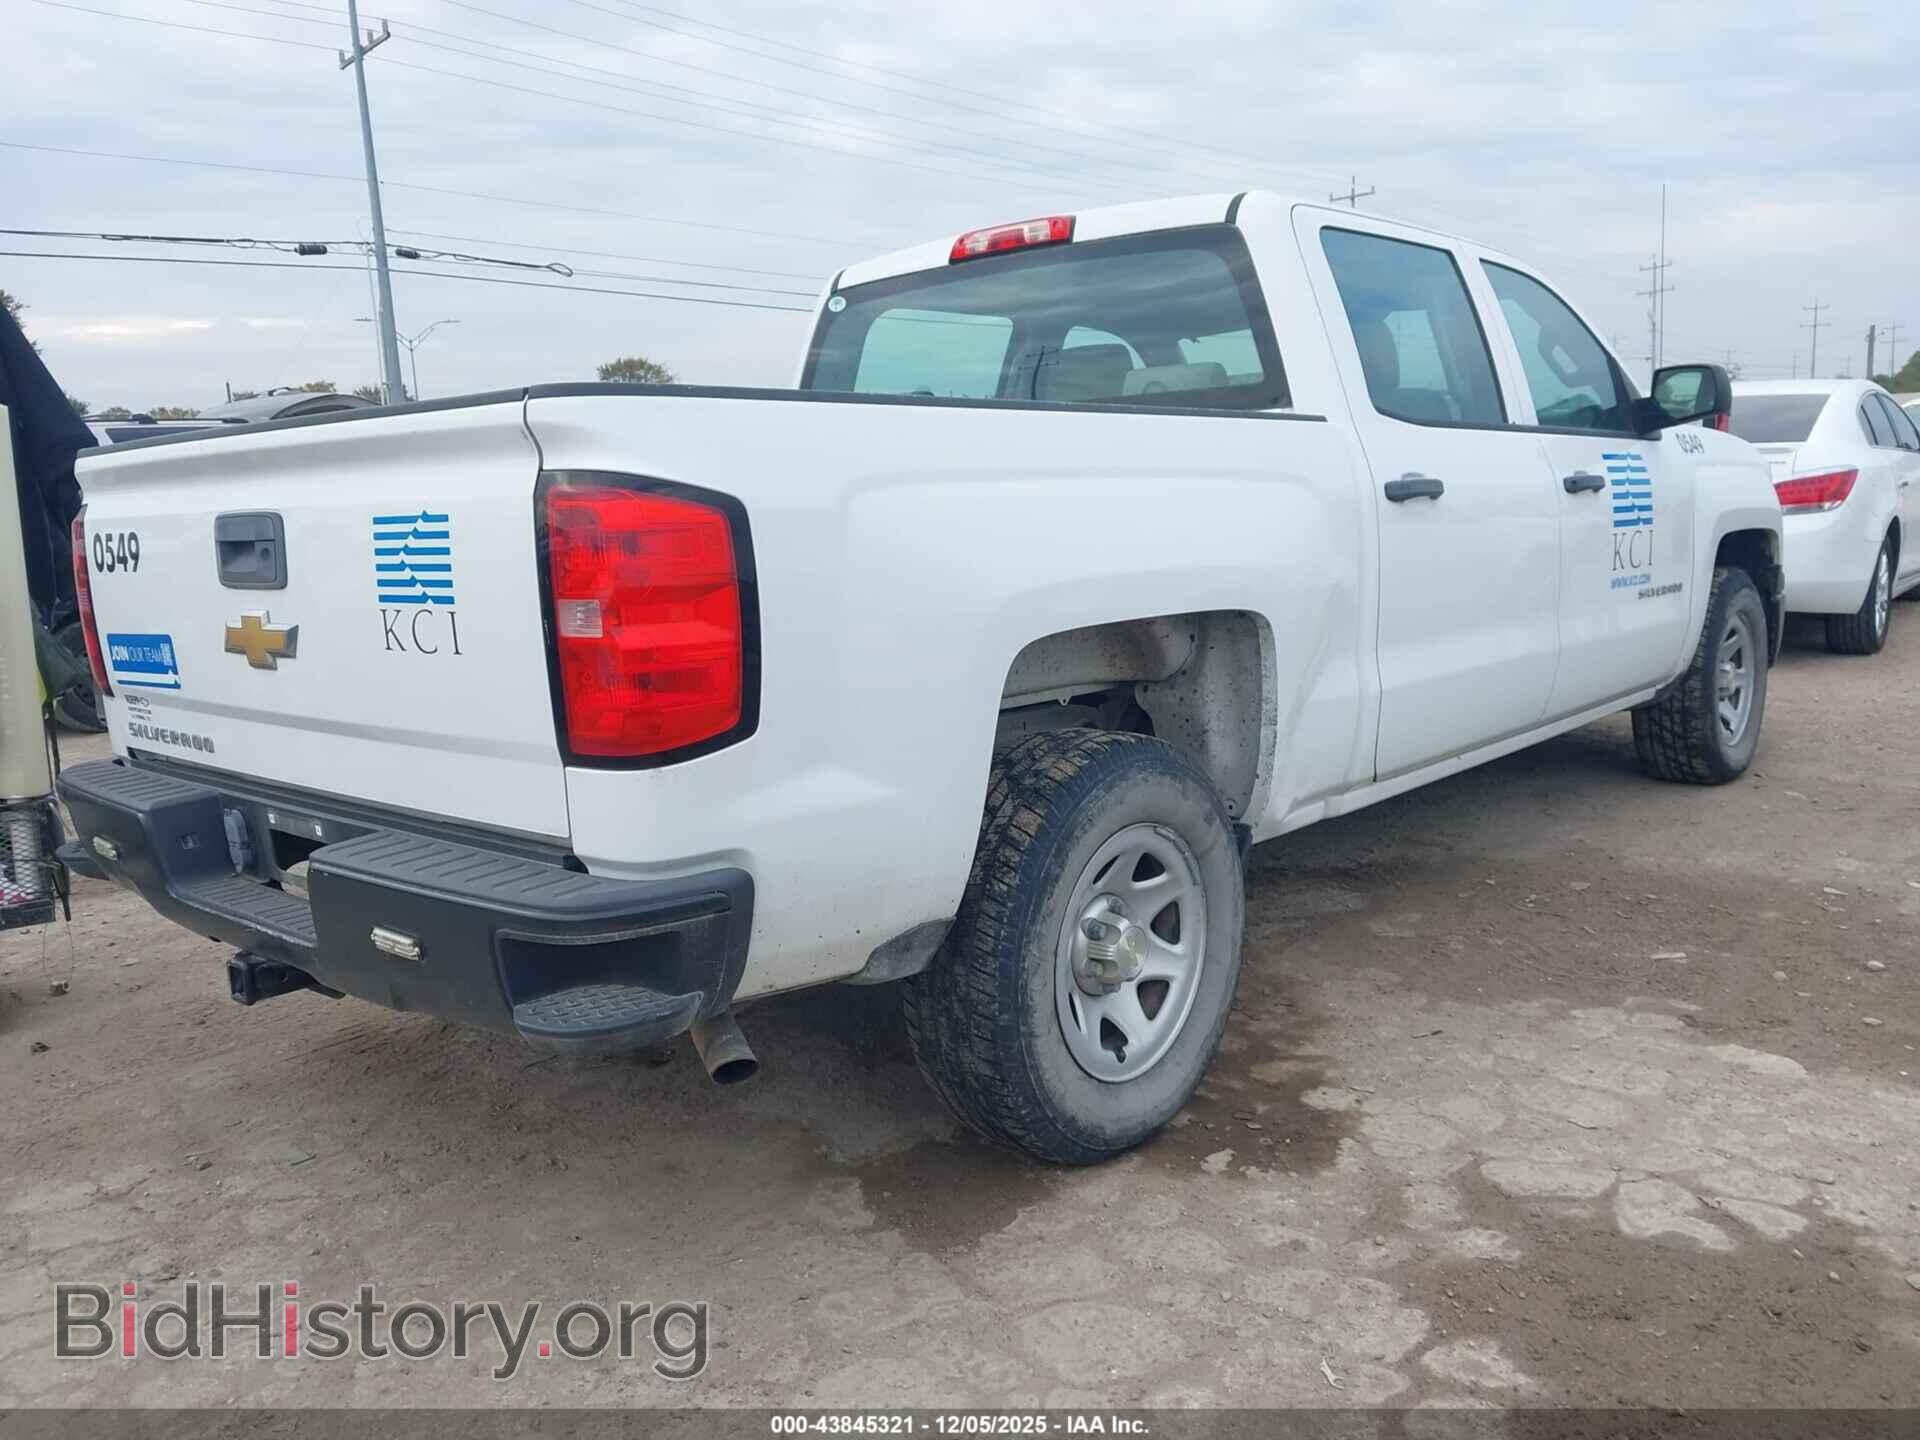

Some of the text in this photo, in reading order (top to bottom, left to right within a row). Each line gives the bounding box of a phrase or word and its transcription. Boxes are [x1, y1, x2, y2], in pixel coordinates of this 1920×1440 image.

[1675, 432, 1704, 454] 0549
[93, 532, 140, 573] 0549
[1612, 530, 1654, 571] KCI
[379, 609, 462, 655] KCI
[111, 645, 129, 661] JOIN
[128, 646, 145, 662] OUR
